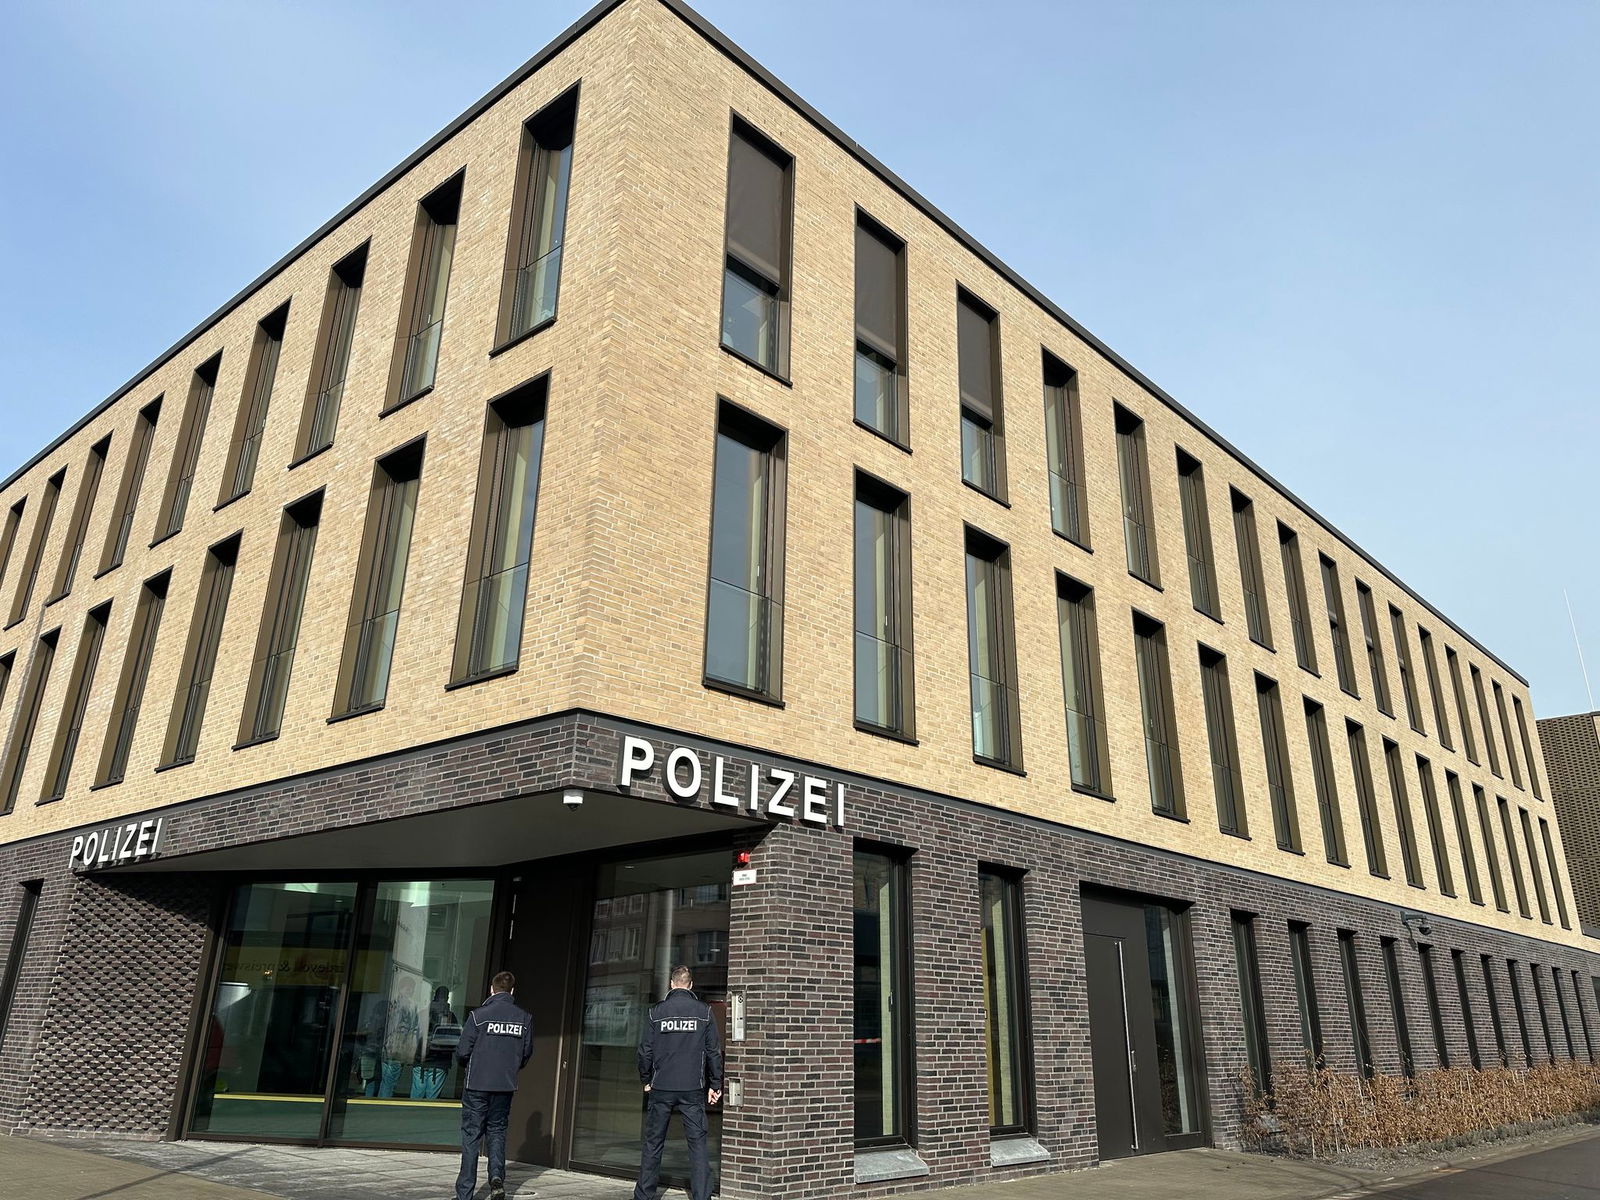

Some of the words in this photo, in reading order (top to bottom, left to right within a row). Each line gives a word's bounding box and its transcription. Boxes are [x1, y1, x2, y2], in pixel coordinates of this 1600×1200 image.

[620, 735, 845, 827] POLIZEI
[68, 817, 163, 869] POLIZEI
[486, 1022, 523, 1036] POLIZEI
[660, 1020, 697, 1032] POLIZEI
